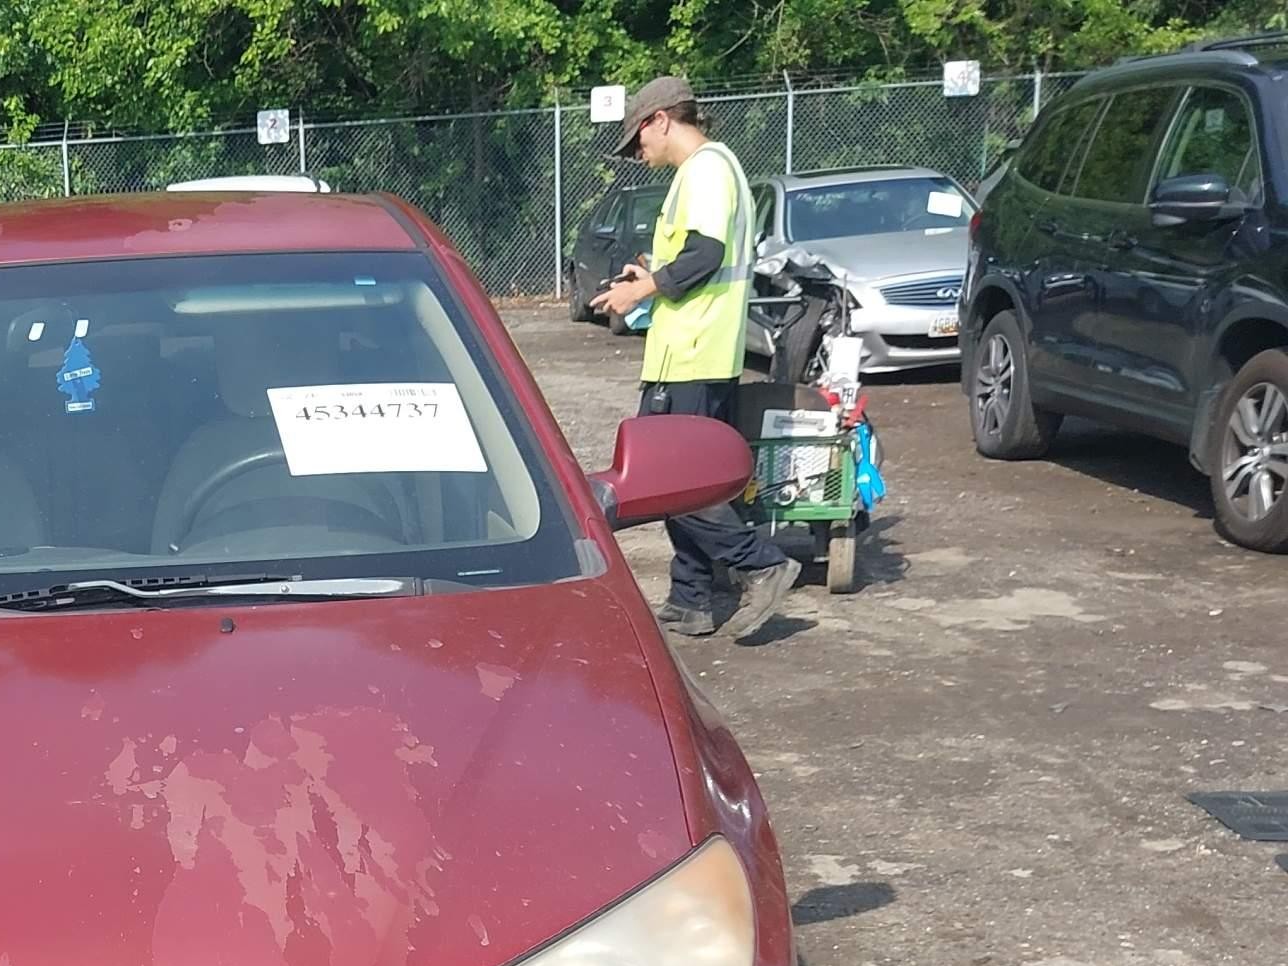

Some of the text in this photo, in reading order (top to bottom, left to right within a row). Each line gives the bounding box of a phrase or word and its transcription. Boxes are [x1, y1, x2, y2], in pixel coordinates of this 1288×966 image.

[603, 95, 613, 107] 3
[269, 118, 278, 129] 2
[295, 403, 439, 421] 45344737
